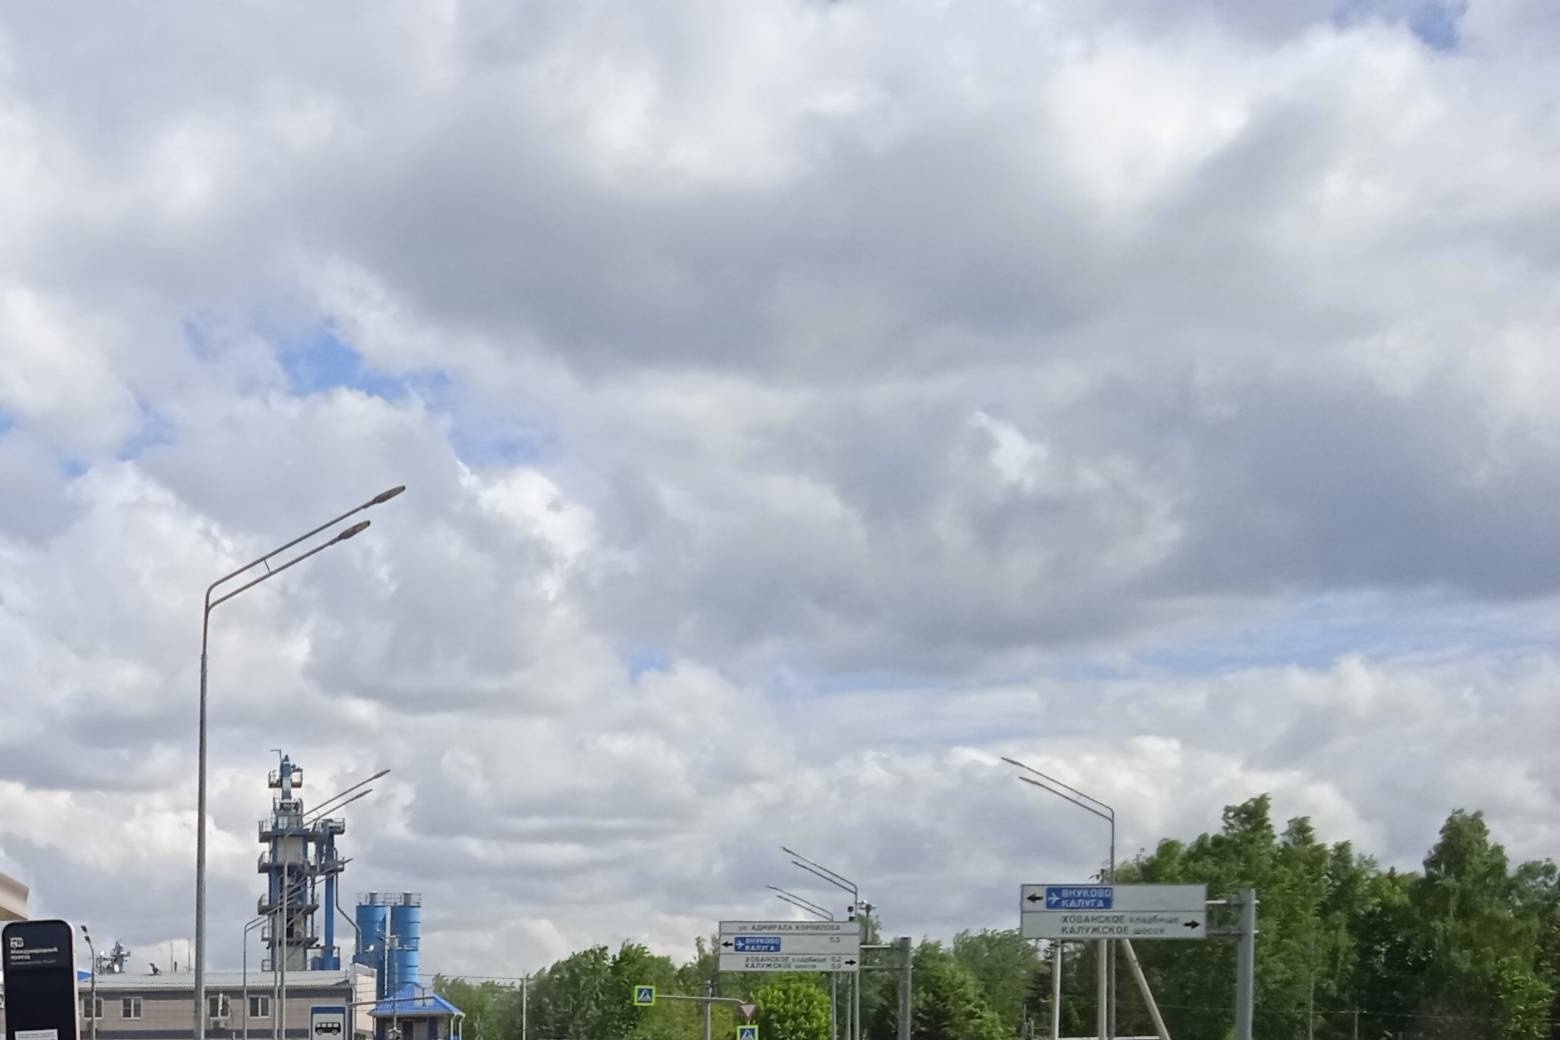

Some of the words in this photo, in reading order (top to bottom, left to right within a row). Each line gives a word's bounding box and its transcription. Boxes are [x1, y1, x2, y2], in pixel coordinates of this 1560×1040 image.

[1061, 889, 1113, 898] ВНУКОВО
[1061, 899, 1104, 908] КАЛУГА
[1061, 926, 1129, 935] КАЛУЖСКОЕ
